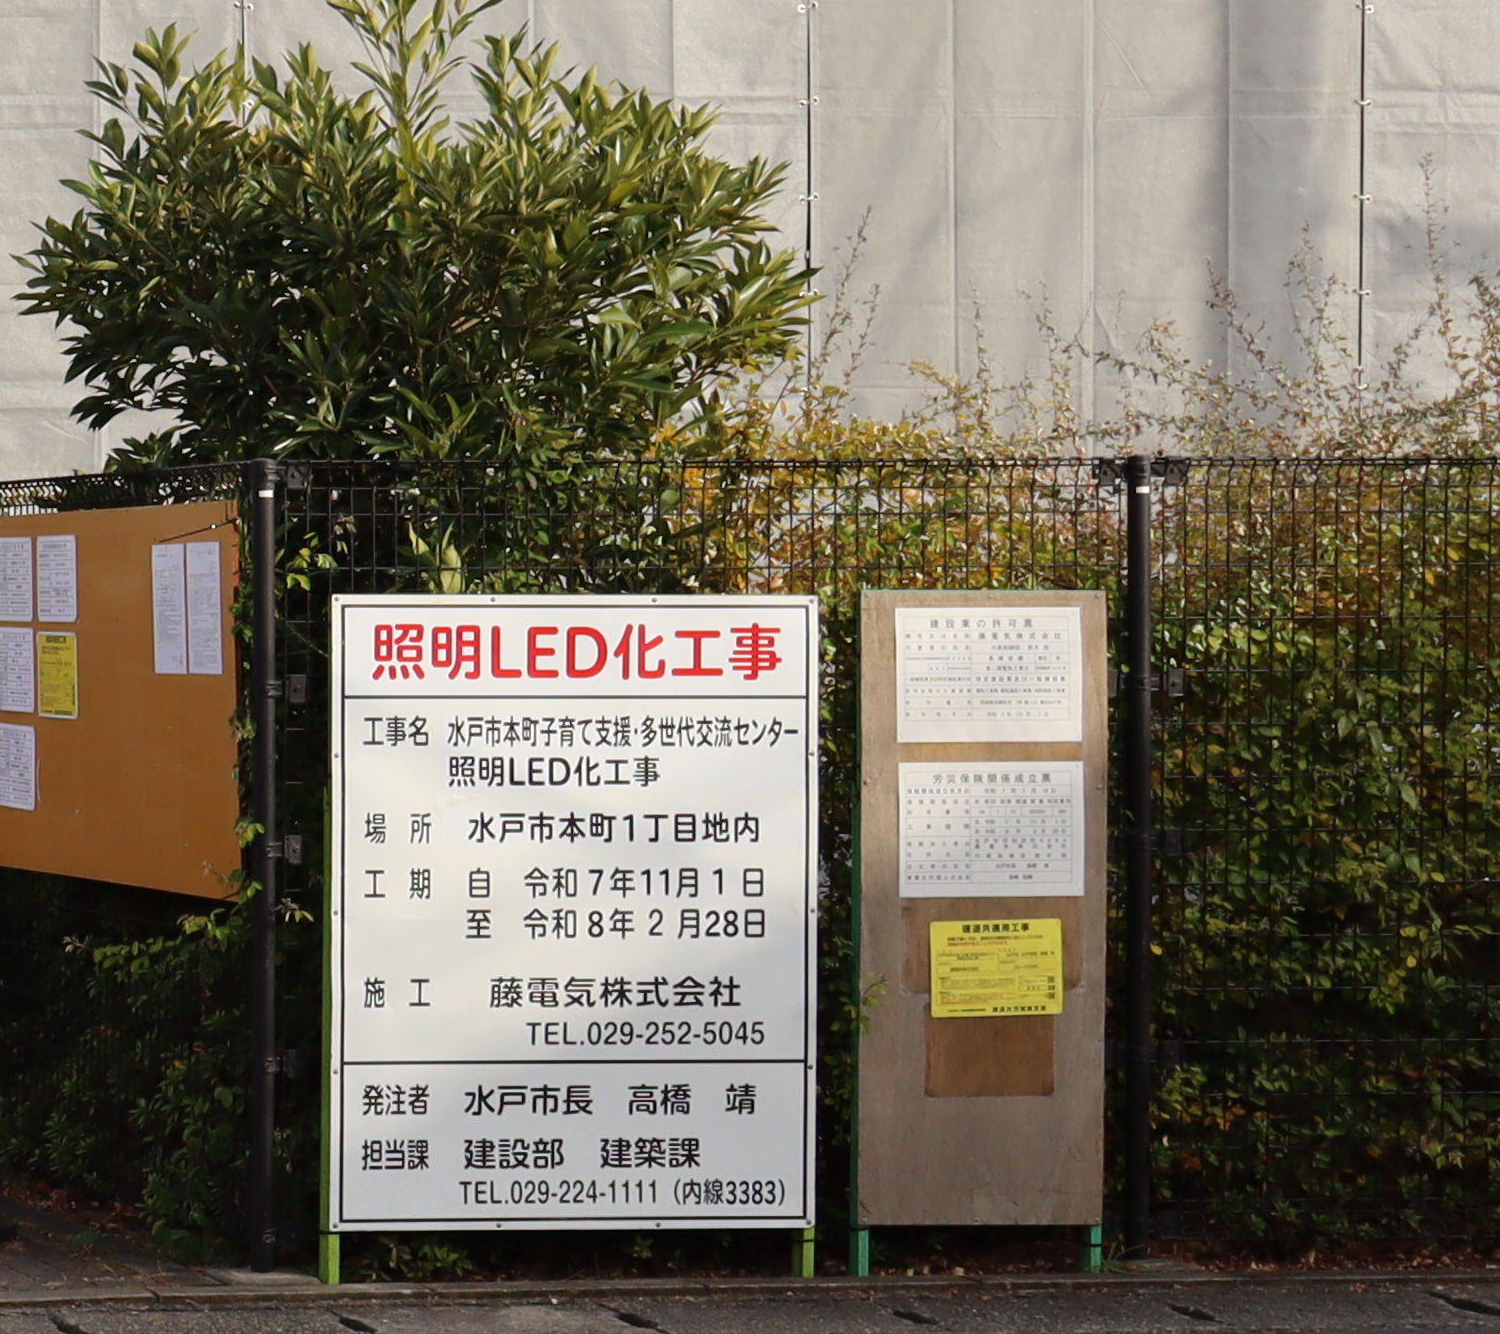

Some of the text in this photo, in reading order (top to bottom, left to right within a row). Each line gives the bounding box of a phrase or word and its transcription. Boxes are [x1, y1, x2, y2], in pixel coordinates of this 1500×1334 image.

[371, 623, 783, 681] 照明LED化工事
[363, 715, 799, 748] 工事名 水戸市本町子育て支援・多世代交流センター
[448, 755, 661, 787] 照明LED化工事
[932, 773, 1052, 784] 労災保険関係成立票
[364, 812, 761, 844] 場所 水戸市本町1丁目地内
[364, 867, 431, 899] 工期
[468, 867, 491, 899] 自
[465, 909, 492, 940] 至
[363, 975, 742, 1009] 施工 藤電気株式会社
[526, 1021, 765, 1047] TEL.029-252-5045
[362, 1083, 757, 1116] 発注者 水戸市長 高橋 靖
[361, 1137, 702, 1171] 担当課 建設部 建築課
[459, 1180, 658, 1206] TEL.029-224-1111
